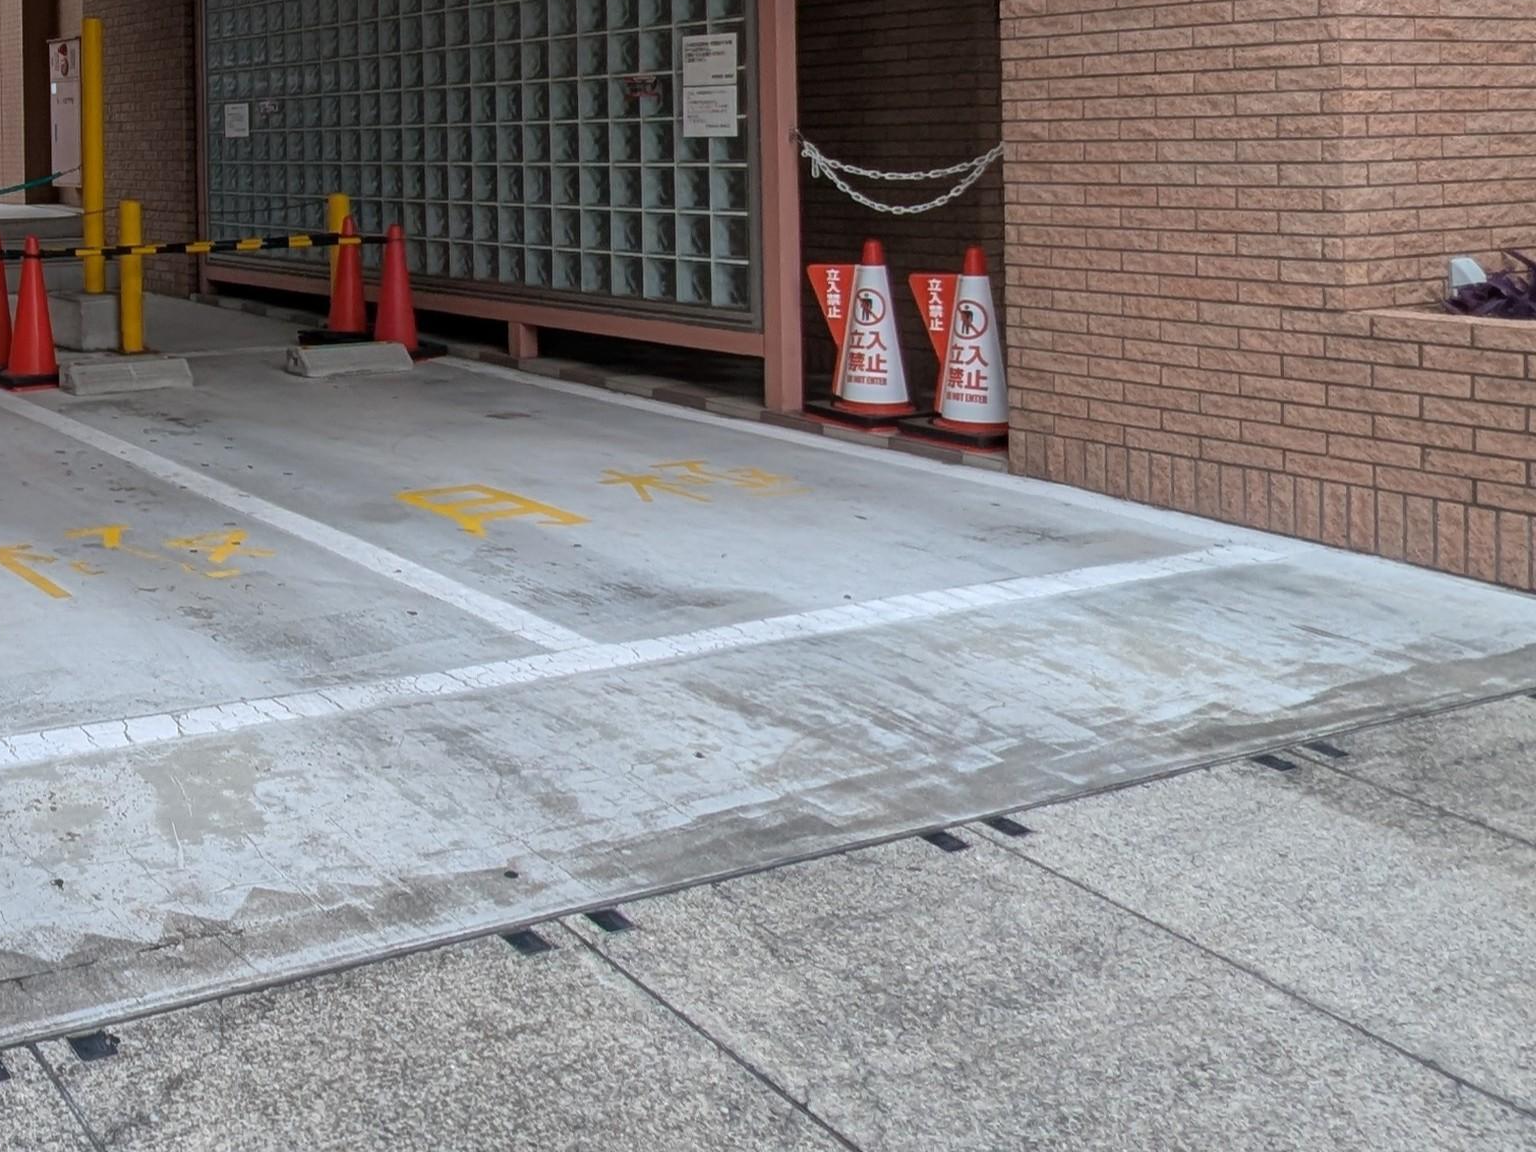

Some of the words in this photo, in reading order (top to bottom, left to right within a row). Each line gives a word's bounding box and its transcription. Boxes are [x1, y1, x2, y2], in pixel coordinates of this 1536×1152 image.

[826, 268, 842, 319] 立入禁止
[927, 278, 945, 331] 立入禁止
[848, 329, 887, 351] 立入
[847, 352, 888, 374] 禁止
[949, 343, 989, 367] 立入
[947, 367, 989, 391] 禁止
